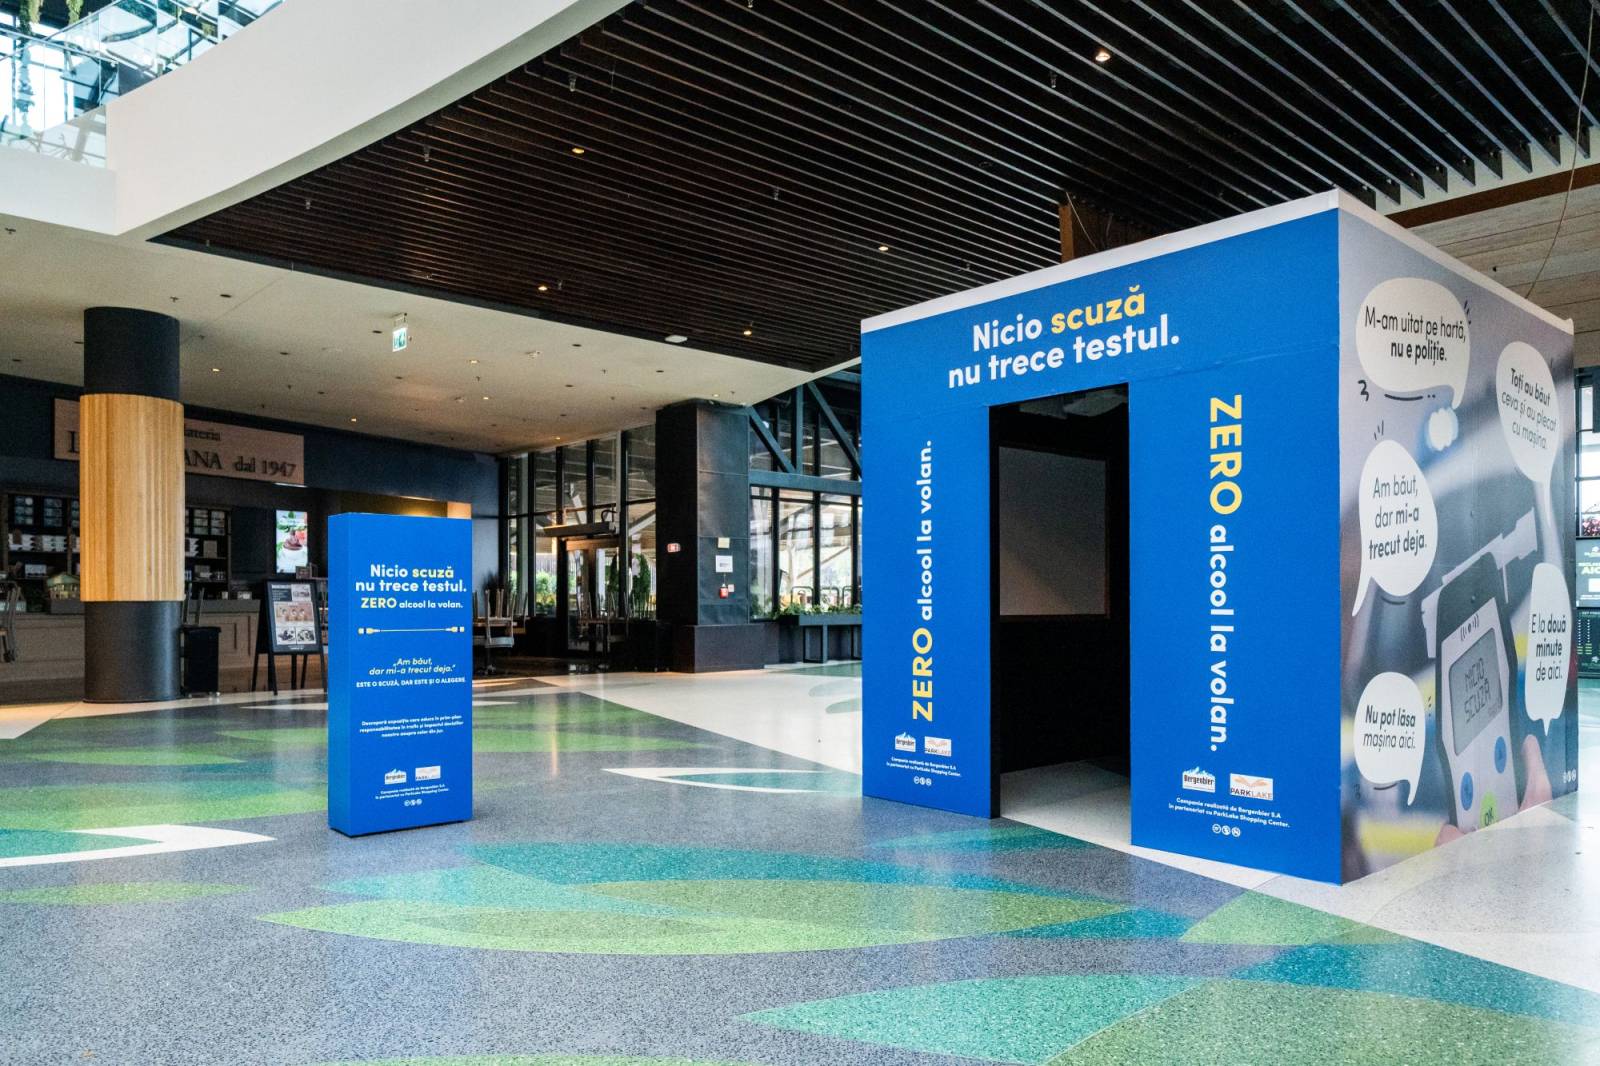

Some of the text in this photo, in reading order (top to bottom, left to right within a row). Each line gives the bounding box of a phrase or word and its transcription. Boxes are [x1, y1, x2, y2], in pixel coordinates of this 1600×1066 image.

[973, 284, 1145, 352] Nicio scuză
[1365, 305, 1466, 343] M-am uitat pe hartă,
[949, 313, 1180, 389] nu trece testul.
[1391, 339, 1447, 366] nu e poliție.
[1511, 367, 1551, 407] Toți au băut
[1502, 391, 1557, 432] ceva și au plecat
[1512, 421, 1520, 436] cu
[234, 455, 256, 473] dal
[262, 460, 297, 478] 1947
[1373, 474, 1418, 498] Am băut,
[1375, 502, 1419, 528] dar mi-a
[1369, 529, 1427, 560] trecut deja.
[370, 564, 454, 578] Nicio scuză
[912, 440, 933, 722] ZERO alcool la volan.
[1210, 394, 1242, 752] ZERO alcool la volan.
[355, 579, 467, 592] nu trece testul.
[360, 597, 464, 609] ZERO alcool la volan.
[1531, 613, 1566, 634] E la două
[1536, 637, 1562, 657] minute
[369, 667, 384, 676] dar
[385, 666, 406, 675] mi-a
[408, 665, 432, 674] trecut
[1464, 657, 1484, 692] NICIO
[1536, 659, 1563, 681] de aici.
[1365, 704, 1416, 731] Nu pot lăsa
[1363, 729, 1416, 752] mașina aici.
[1183, 774, 1273, 800] Bergenbier PARKLAKE
[1238, 806, 1270, 818] Bergenbier
[1239, 814, 1267, 825] Shopping
[1484, 807, 1494, 827] OK
